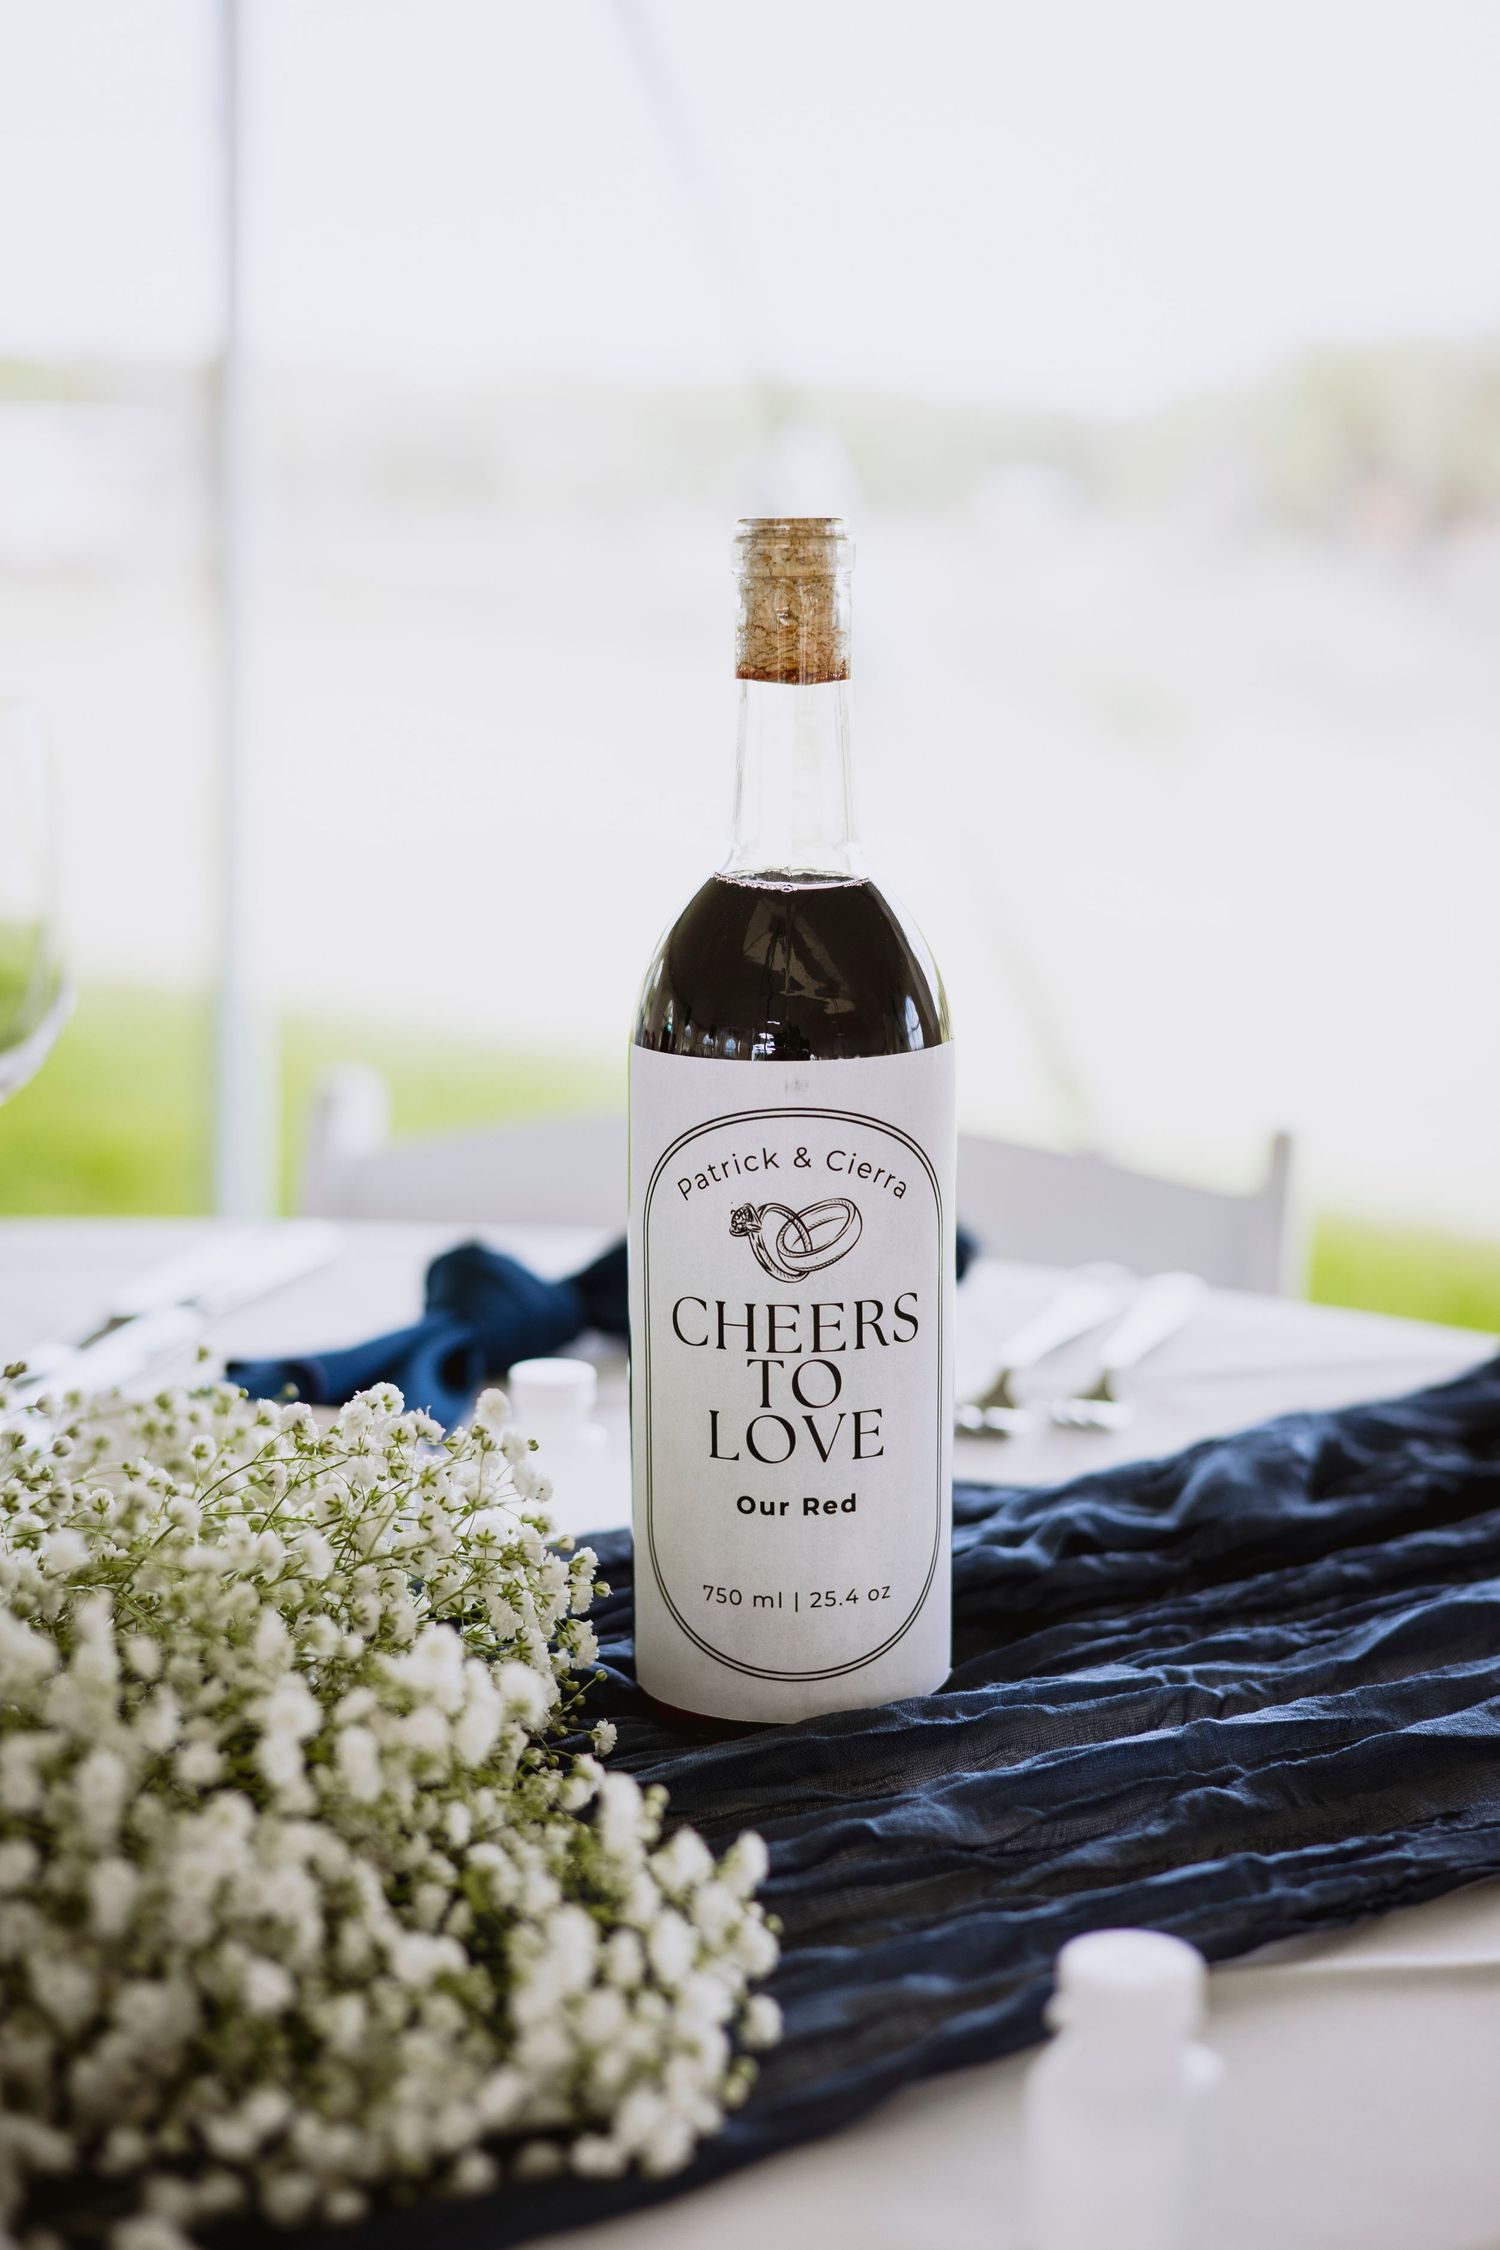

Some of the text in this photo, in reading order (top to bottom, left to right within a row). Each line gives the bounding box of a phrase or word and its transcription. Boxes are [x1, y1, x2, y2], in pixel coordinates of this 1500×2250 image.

[677, 1146, 907, 1201] Patrick & Cierra
[672, 1292, 919, 1354] CHEERS
[746, 1358, 842, 1409] TO
[708, 1408, 884, 1464] LOVE
[736, 1493, 857, 1516] Our Red
[702, 1584, 743, 1606] 750
[753, 1591, 782, 1609] ml
[809, 1588, 860, 1609] 25.4
[867, 1585, 891, 1602] oz
